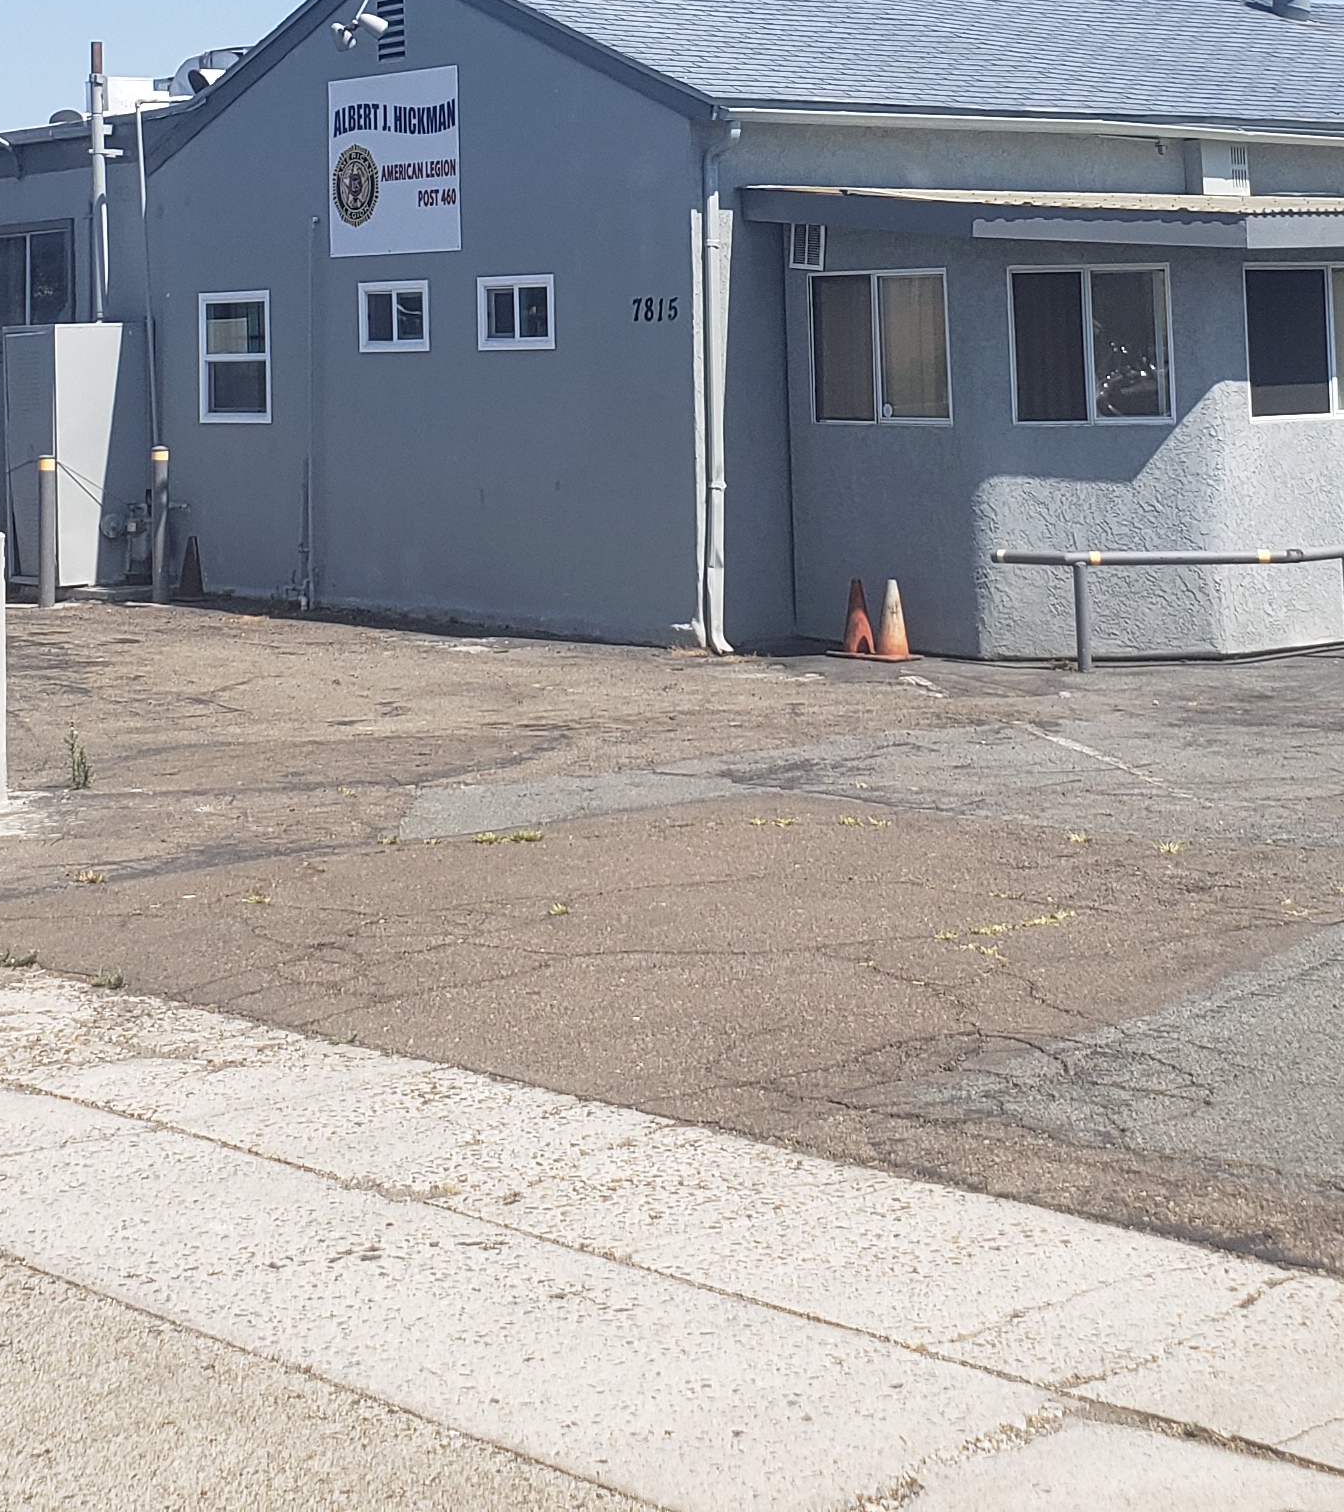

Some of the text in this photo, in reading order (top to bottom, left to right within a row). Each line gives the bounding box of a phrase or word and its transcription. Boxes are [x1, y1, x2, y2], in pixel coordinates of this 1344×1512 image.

[333, 97, 456, 138] ALBERT J. HICKMAN
[381, 158, 456, 182] AMERICAN LEGION
[418, 188, 457, 208] POST 460
[632, 296, 679, 322] 7815
